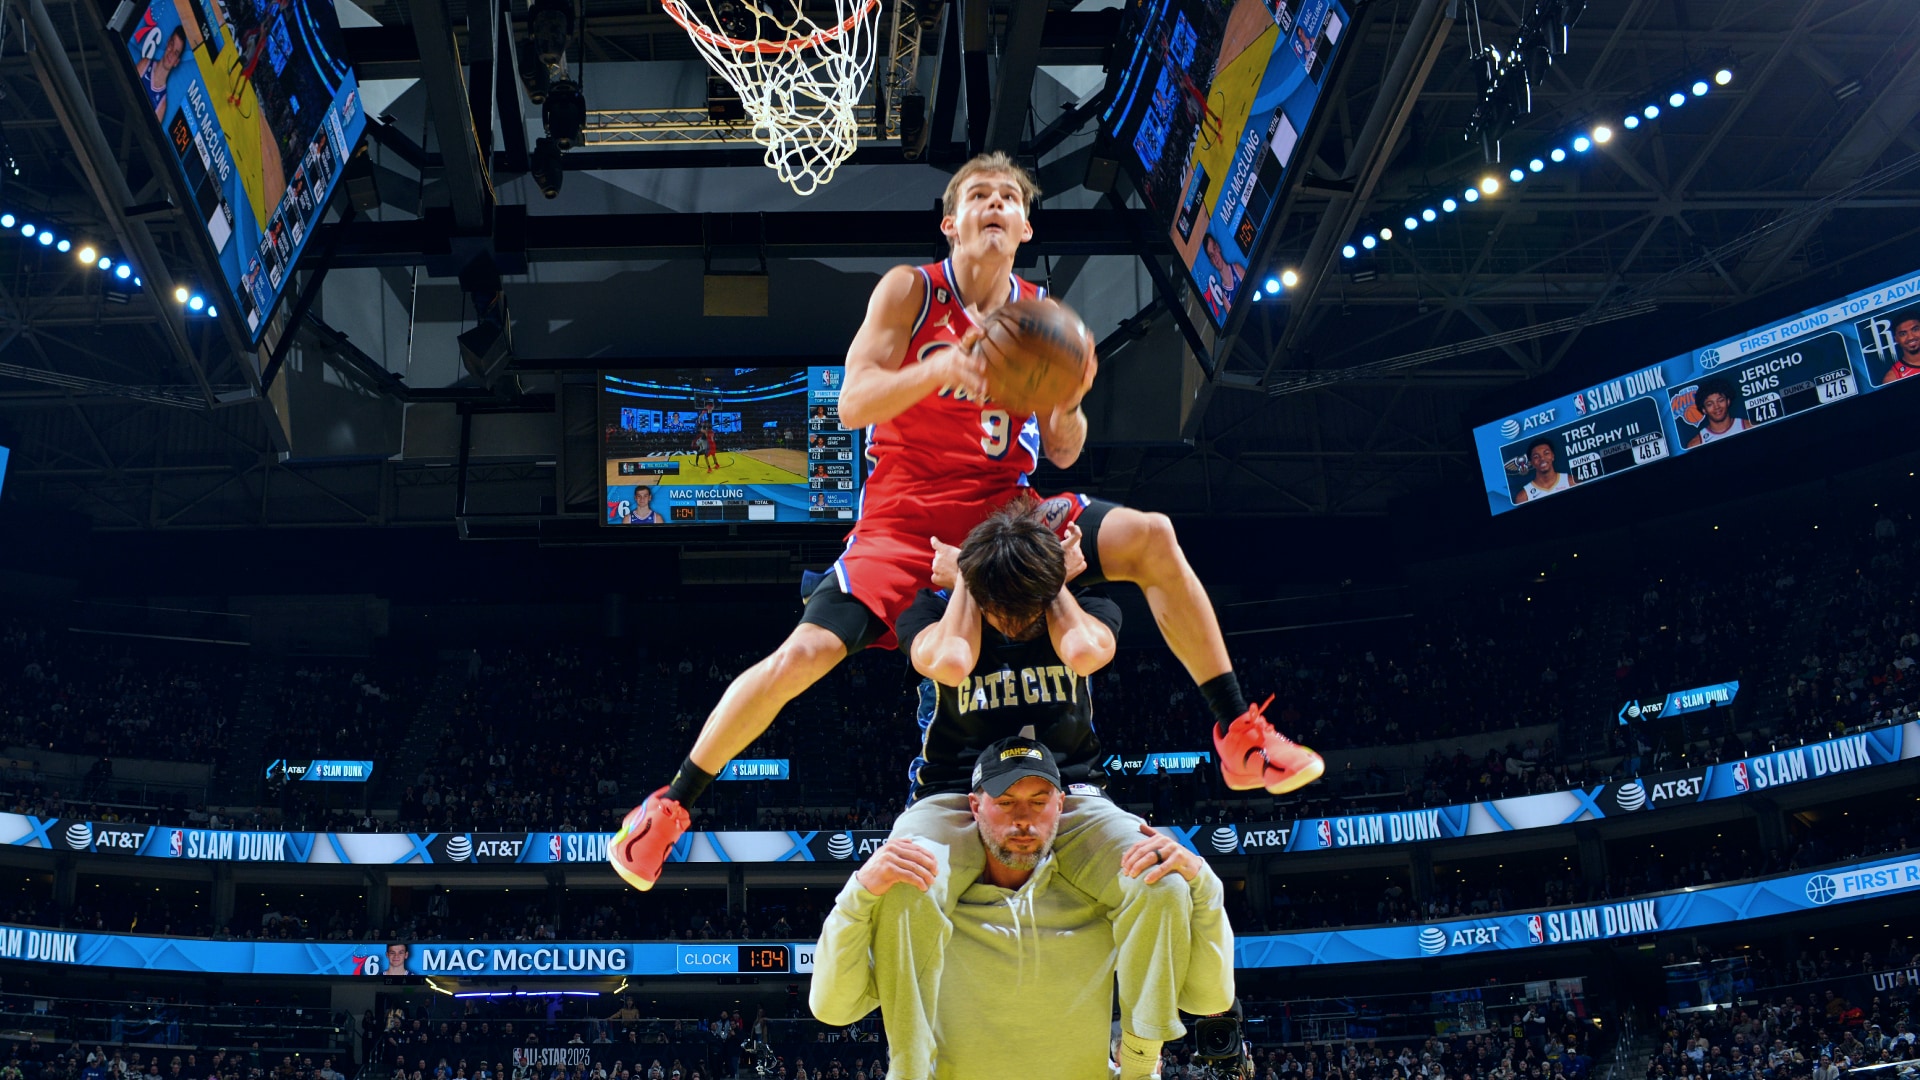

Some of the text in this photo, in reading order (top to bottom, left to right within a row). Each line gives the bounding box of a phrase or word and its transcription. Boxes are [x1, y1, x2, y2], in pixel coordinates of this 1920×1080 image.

[187, 79, 206, 119] MAC
[1220, 129, 1260, 225] MAC McCLUNG
[937, 288, 947, 303] 6
[1739, 333, 1778, 352] FIRST
[1781, 313, 1829, 339] ROUND
[1840, 299, 1870, 316] TOP
[1874, 293, 1884, 306] 2
[1738, 352, 1803, 384] JERICHO
[1820, 370, 1846, 383] TOTAL
[1587, 367, 1666, 412] SLAM DUNK
[1741, 375, 1779, 396] SIMS
[1825, 379, 1848, 399] 47.6
[1750, 396, 1769, 407] DUNK
[1523, 408, 1556, 430] AT&T
[1755, 402, 1777, 421] 47.6
[980, 409, 1012, 460] 9
[1562, 422, 1596, 443] TREY
[1565, 422, 1640, 457] MURPHY III
[1635, 433, 1659, 445] TOTAL
[1639, 442, 1660, 460] 46.6
[1573, 456, 1591, 466] DUNK
[1577, 461, 1598, 480] 46.6
[669, 489, 744, 499] MAC McCLUNG
[676, 508, 694, 518] 1:04
[957, 665, 1078, 715] GATE CITY
[1683, 688, 1729, 708] SLAM DUNK
[1641, 703, 1663, 714] AT&T
[1000, 748, 1020, 759] UTAH
[1160, 757, 1179, 769] SLAM
[1753, 735, 1872, 788] SLAM DUNK
[287, 766, 306, 774] AT&T
[323, 766, 362, 777] SLAM DUNK
[739, 764, 779, 775] SLAM DUNK
[1124, 760, 1142, 768] AT&T
[1651, 777, 1702, 801] AT&T
[1337, 810, 1441, 846] SLAM DUNK
[96, 831, 144, 849] AT&T
[188, 831, 286, 861] SLAM DUNK
[1243, 829, 1290, 847] AT&T
[476, 840, 523, 857] AT&T
[1844, 864, 1920, 892] FIRST R
[1548, 900, 1658, 942] SLAM DUNK
[1451, 926, 1500, 946] AT&T
[27, 931, 77, 962] DUNK
[353, 948, 626, 975] 76 MAC McCLUNG
[685, 953, 731, 965] CLOCK
[751, 950, 783, 968] 1:04
[567, 1048, 590, 1066] 2023
